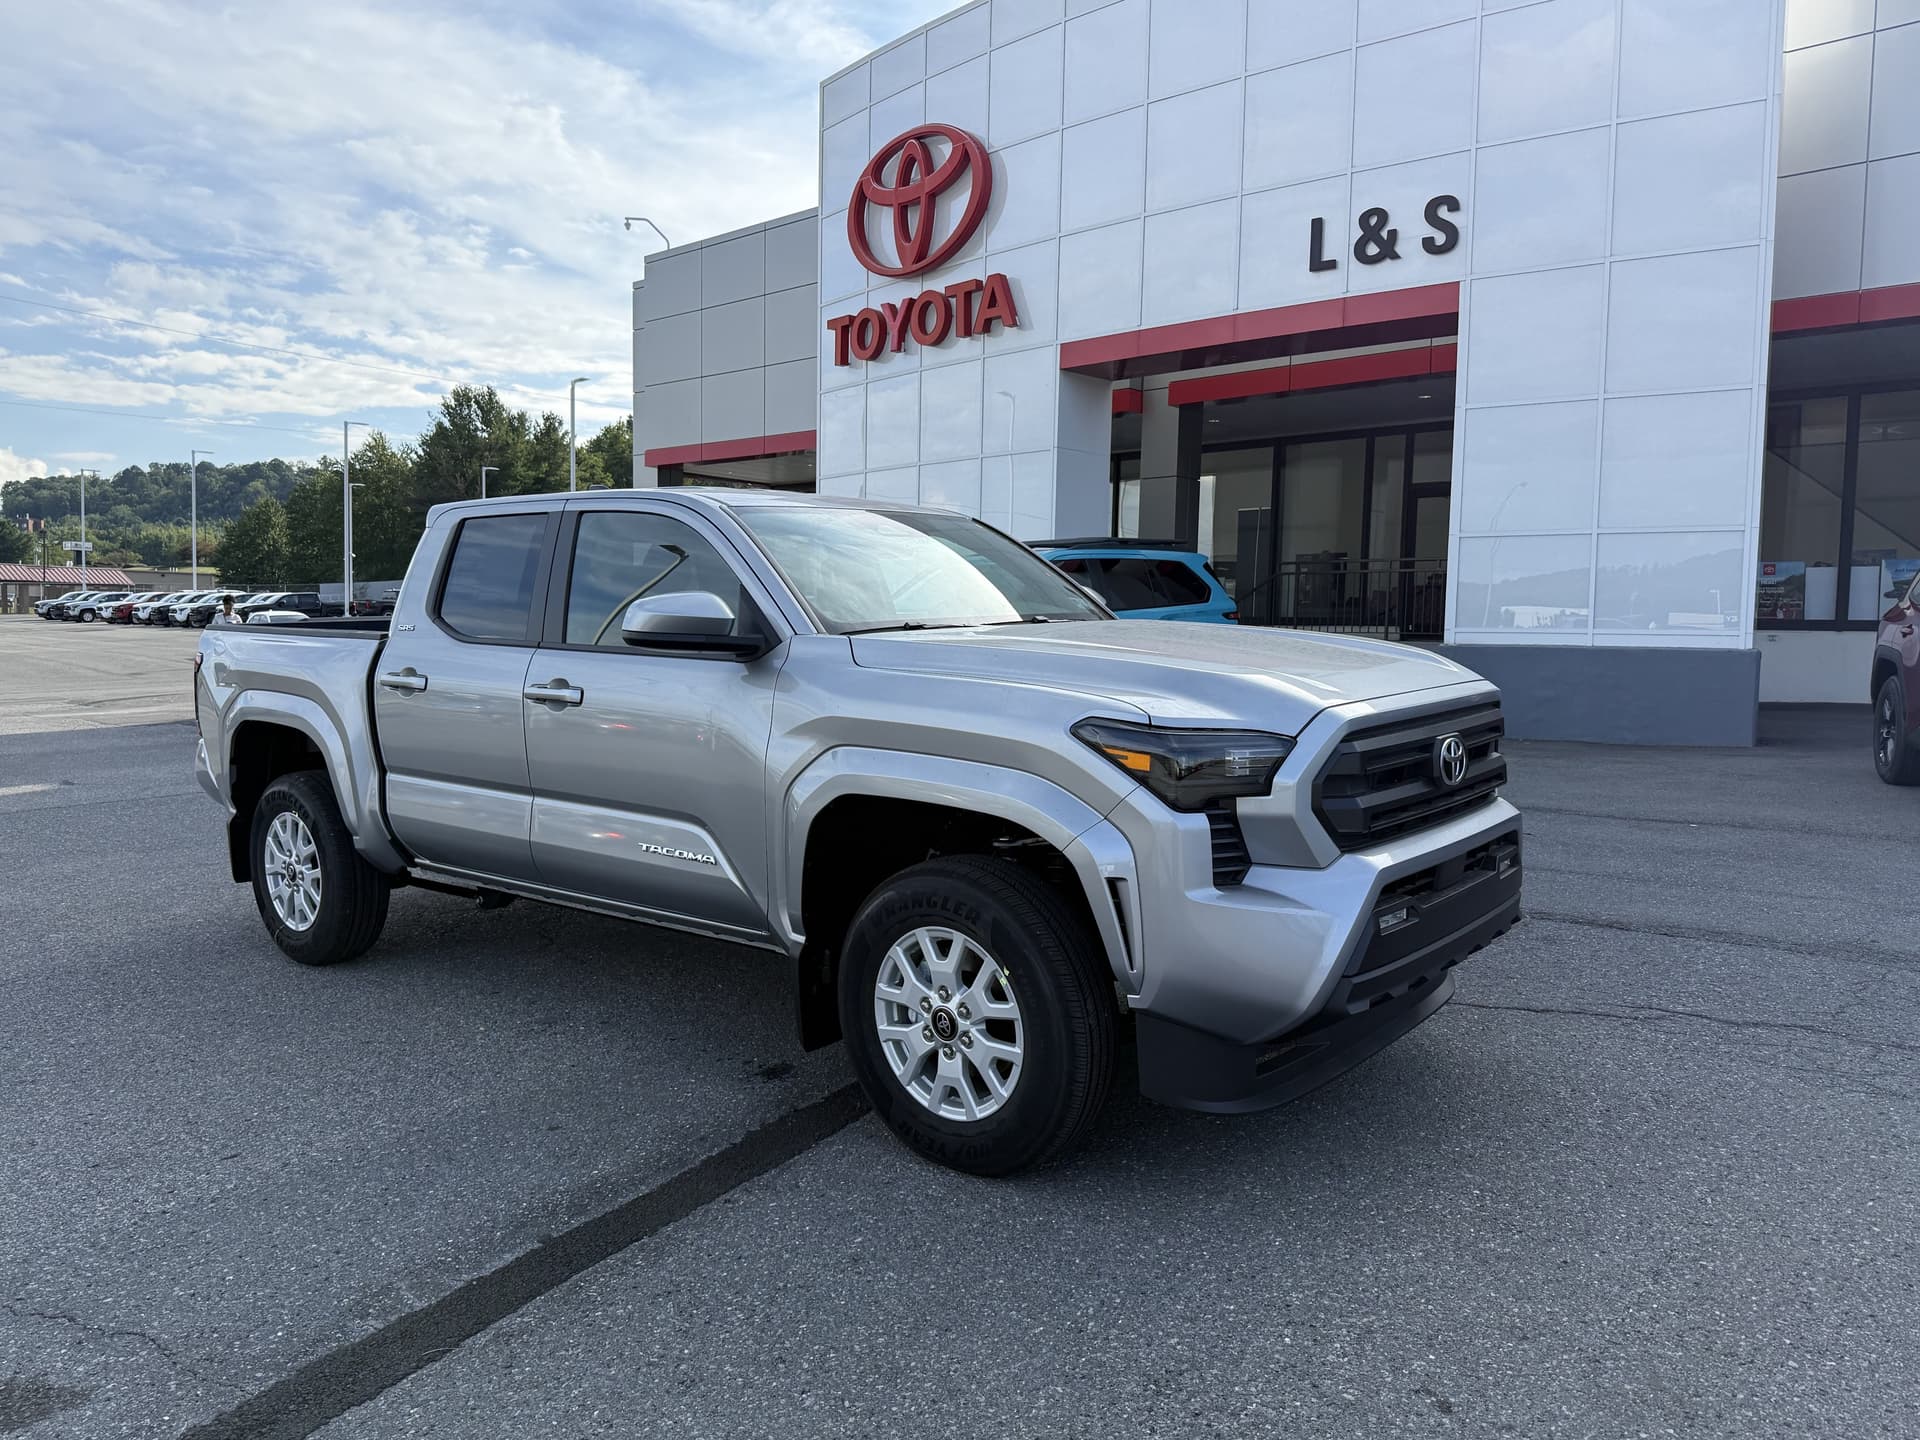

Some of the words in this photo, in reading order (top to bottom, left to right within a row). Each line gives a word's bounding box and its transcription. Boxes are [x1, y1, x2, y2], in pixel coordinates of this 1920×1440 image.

[1309, 217, 1337, 272] L
[1353, 207, 1402, 265] &
[1421, 195, 1461, 255] S
[827, 273, 1018, 366] TOYOTA
[638, 842, 717, 865] TACOMA
